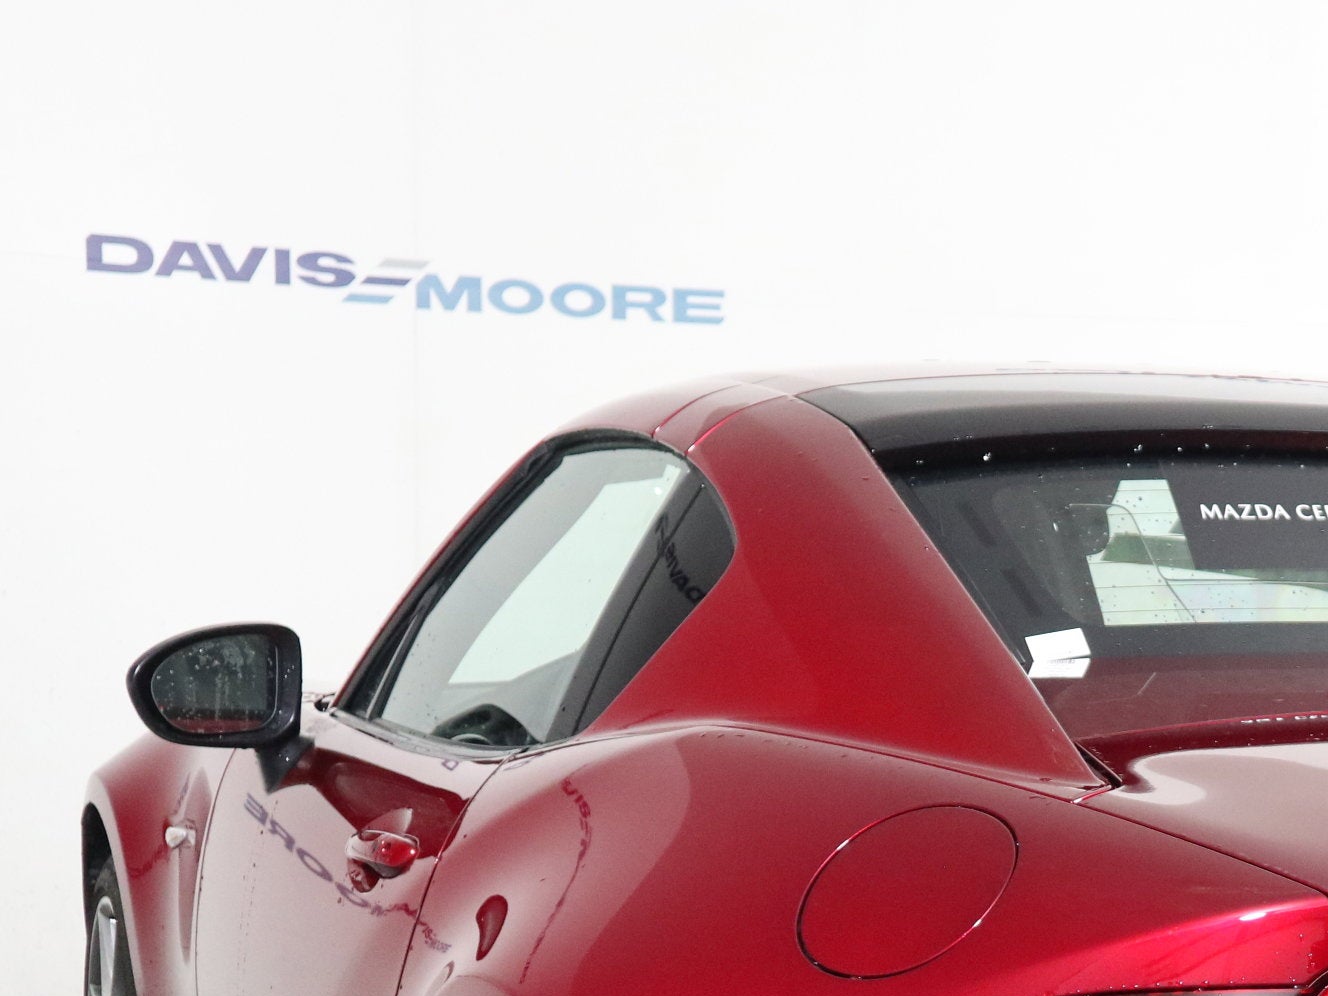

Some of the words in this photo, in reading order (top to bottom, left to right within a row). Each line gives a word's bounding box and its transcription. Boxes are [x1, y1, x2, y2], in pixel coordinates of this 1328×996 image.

[86, 234, 356, 288] DAVIS
[414, 274, 725, 325] MOORE
[1199, 503, 1291, 521] MAZDA
